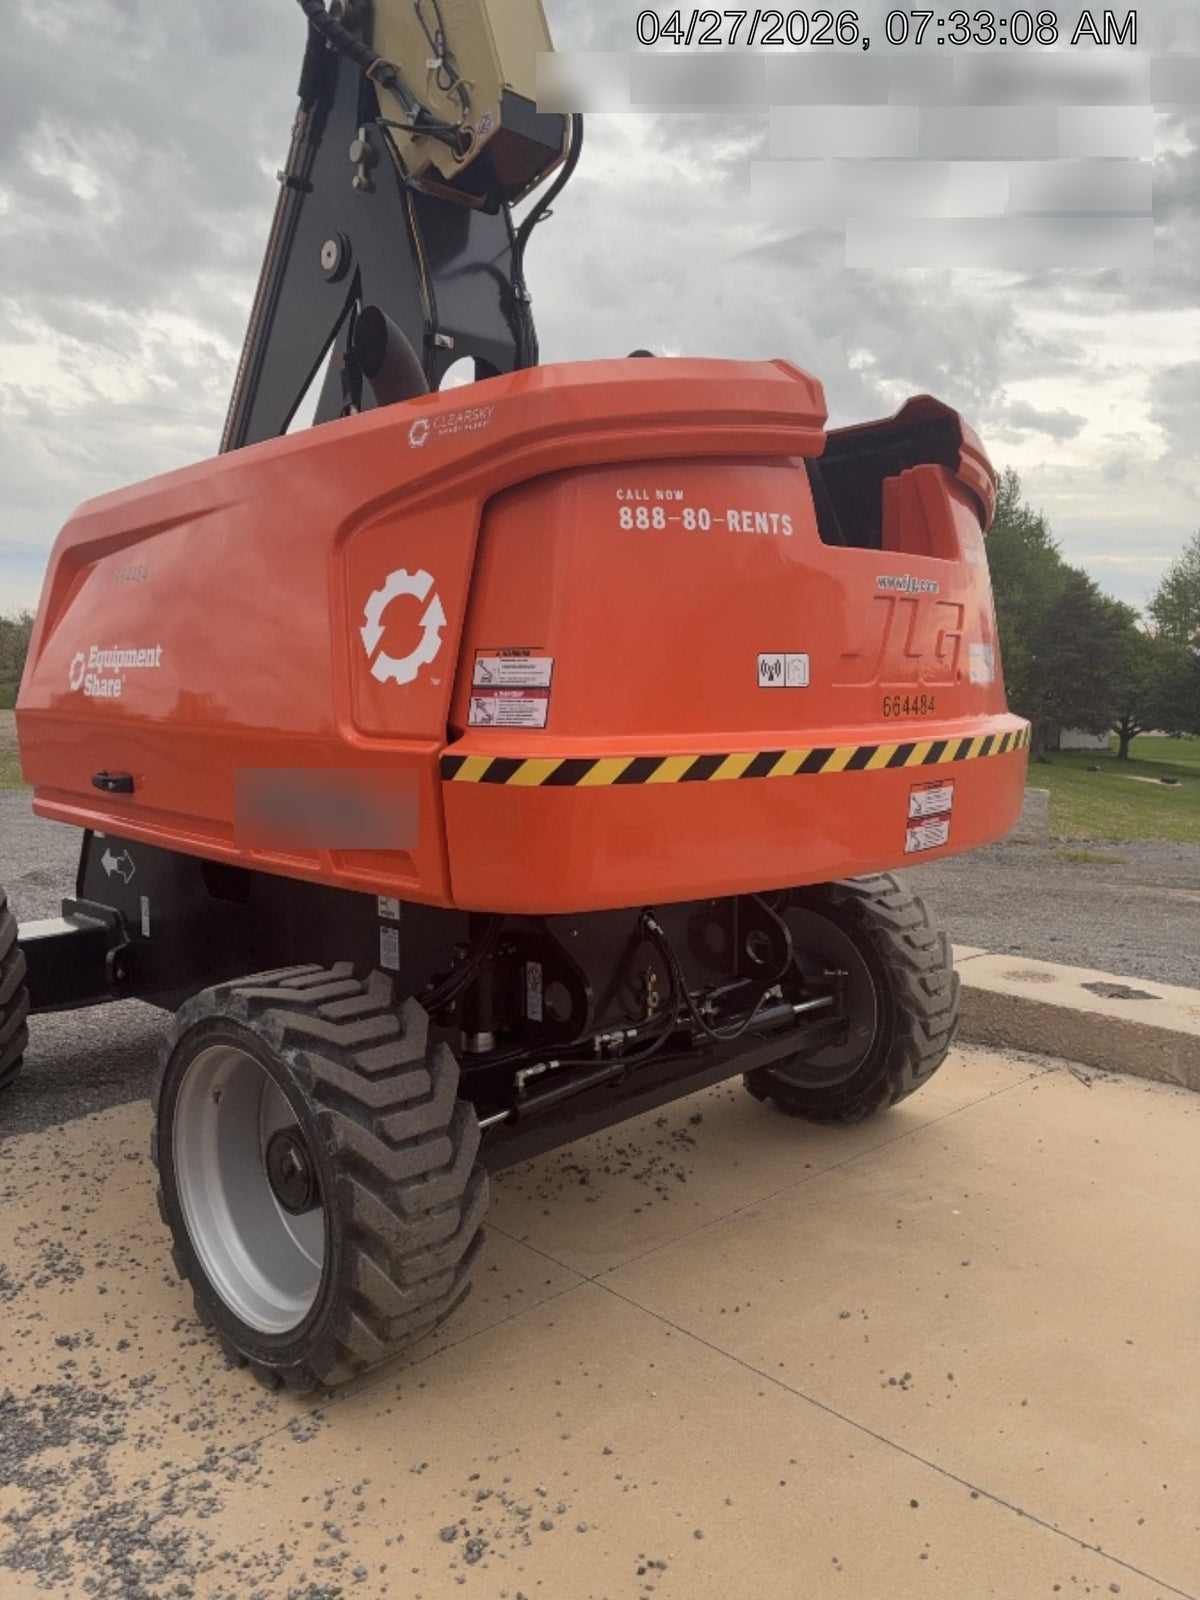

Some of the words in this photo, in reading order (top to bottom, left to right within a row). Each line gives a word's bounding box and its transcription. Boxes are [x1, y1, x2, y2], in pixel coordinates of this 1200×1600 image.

[616, 489, 650, 500] CALL
[656, 490, 684, 500] NOW
[618, 506, 793, 536] 888-80-RENTS
[88, 644, 163, 673] Equipment
[83, 673, 122, 698] Share
[882, 694, 936, 717] 664484
